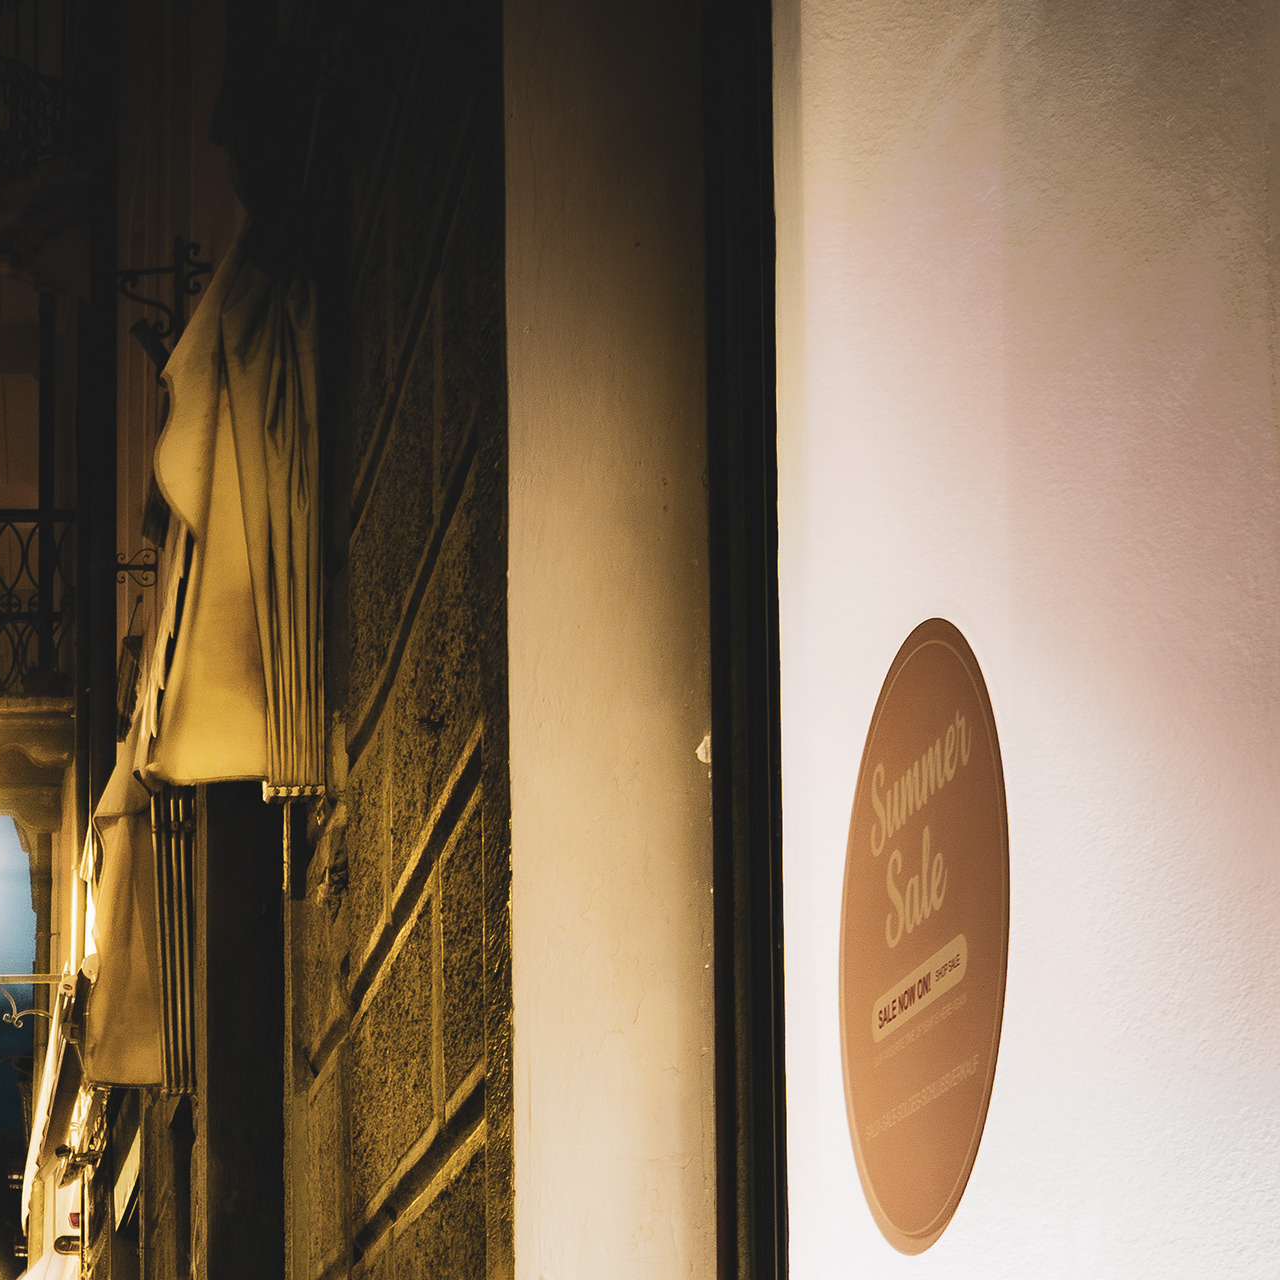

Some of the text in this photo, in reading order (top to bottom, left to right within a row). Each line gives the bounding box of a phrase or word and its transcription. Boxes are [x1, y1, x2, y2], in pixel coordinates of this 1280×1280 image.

[871, 711, 972, 858] Summer
[885, 825, 948, 949] Sale
[878, 998, 897, 1029] SALE
[898, 983, 916, 1015] NOW
[917, 971, 932, 1000] ON!
[935, 962, 948, 982] SHOP
[948, 953, 961, 973] SALE
